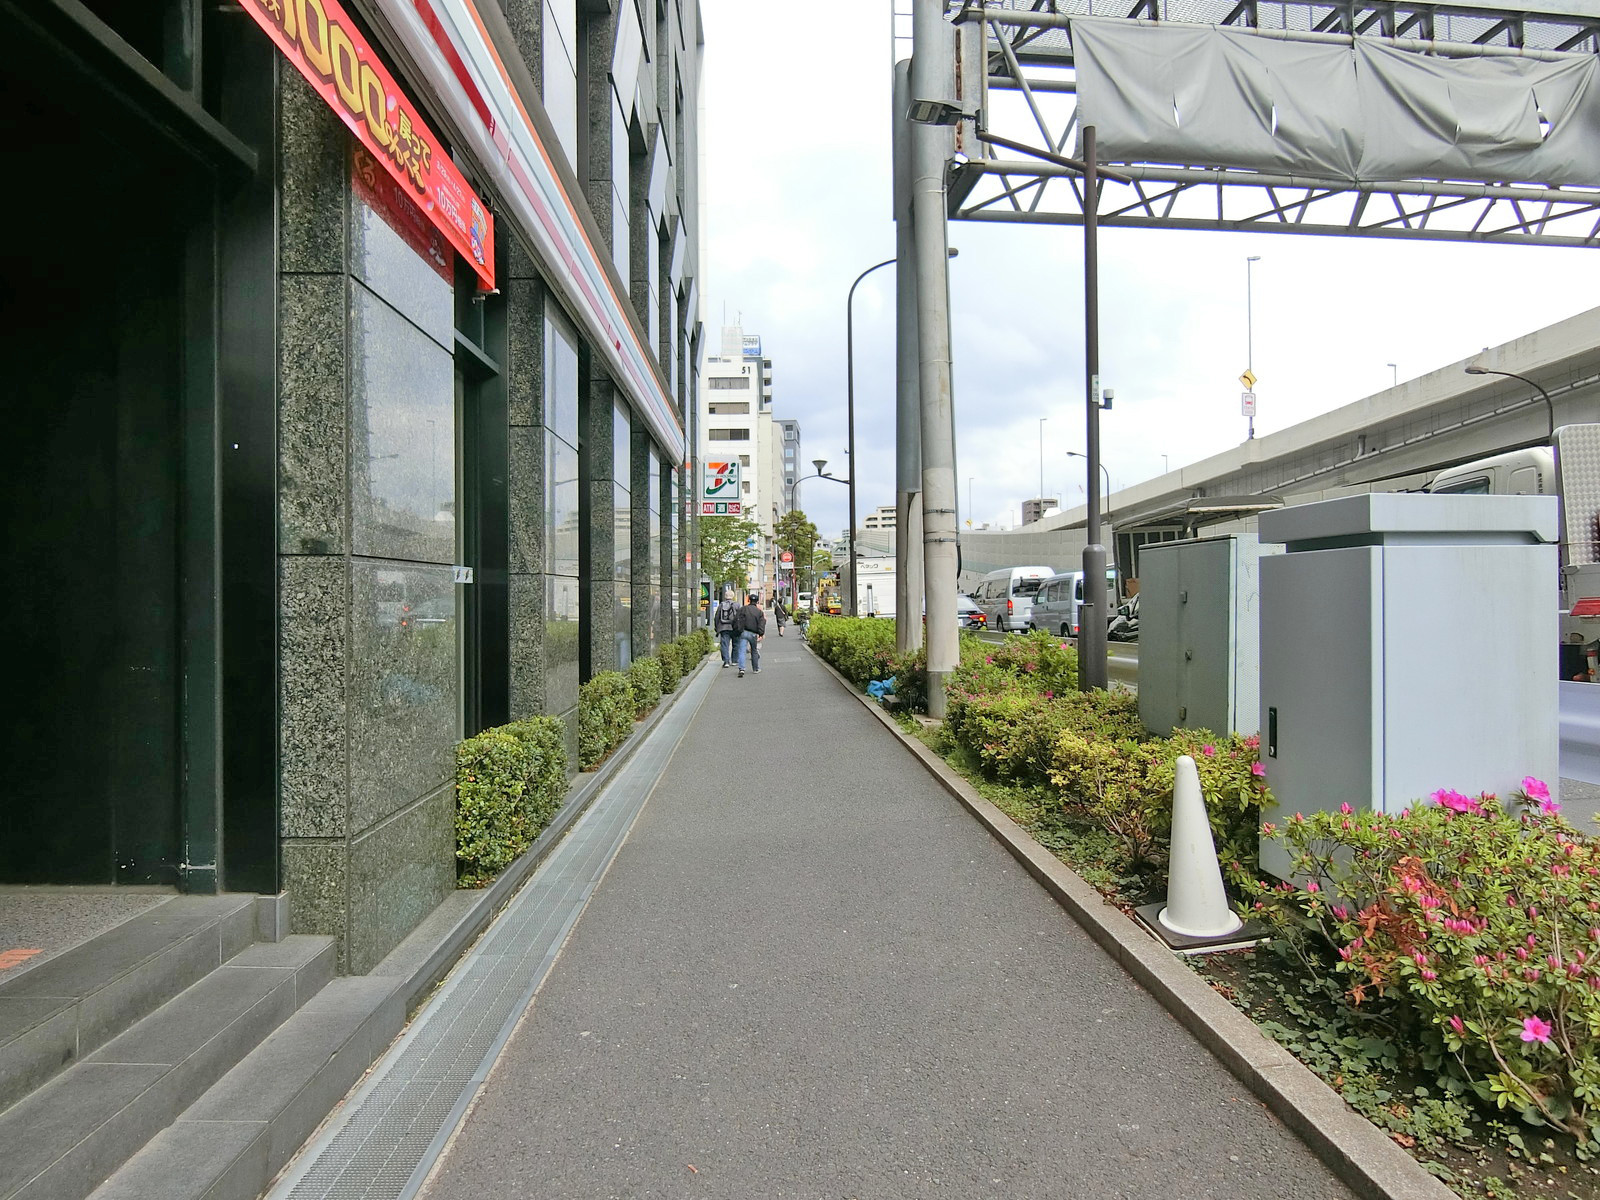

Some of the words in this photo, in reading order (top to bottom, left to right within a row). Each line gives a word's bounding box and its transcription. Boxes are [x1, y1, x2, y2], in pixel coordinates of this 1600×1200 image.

[399, 109, 431, 169] 戻って
[403, 150, 425, 188] くる
[741, 366, 751, 375] 51
[703, 504, 715, 513] ATM
